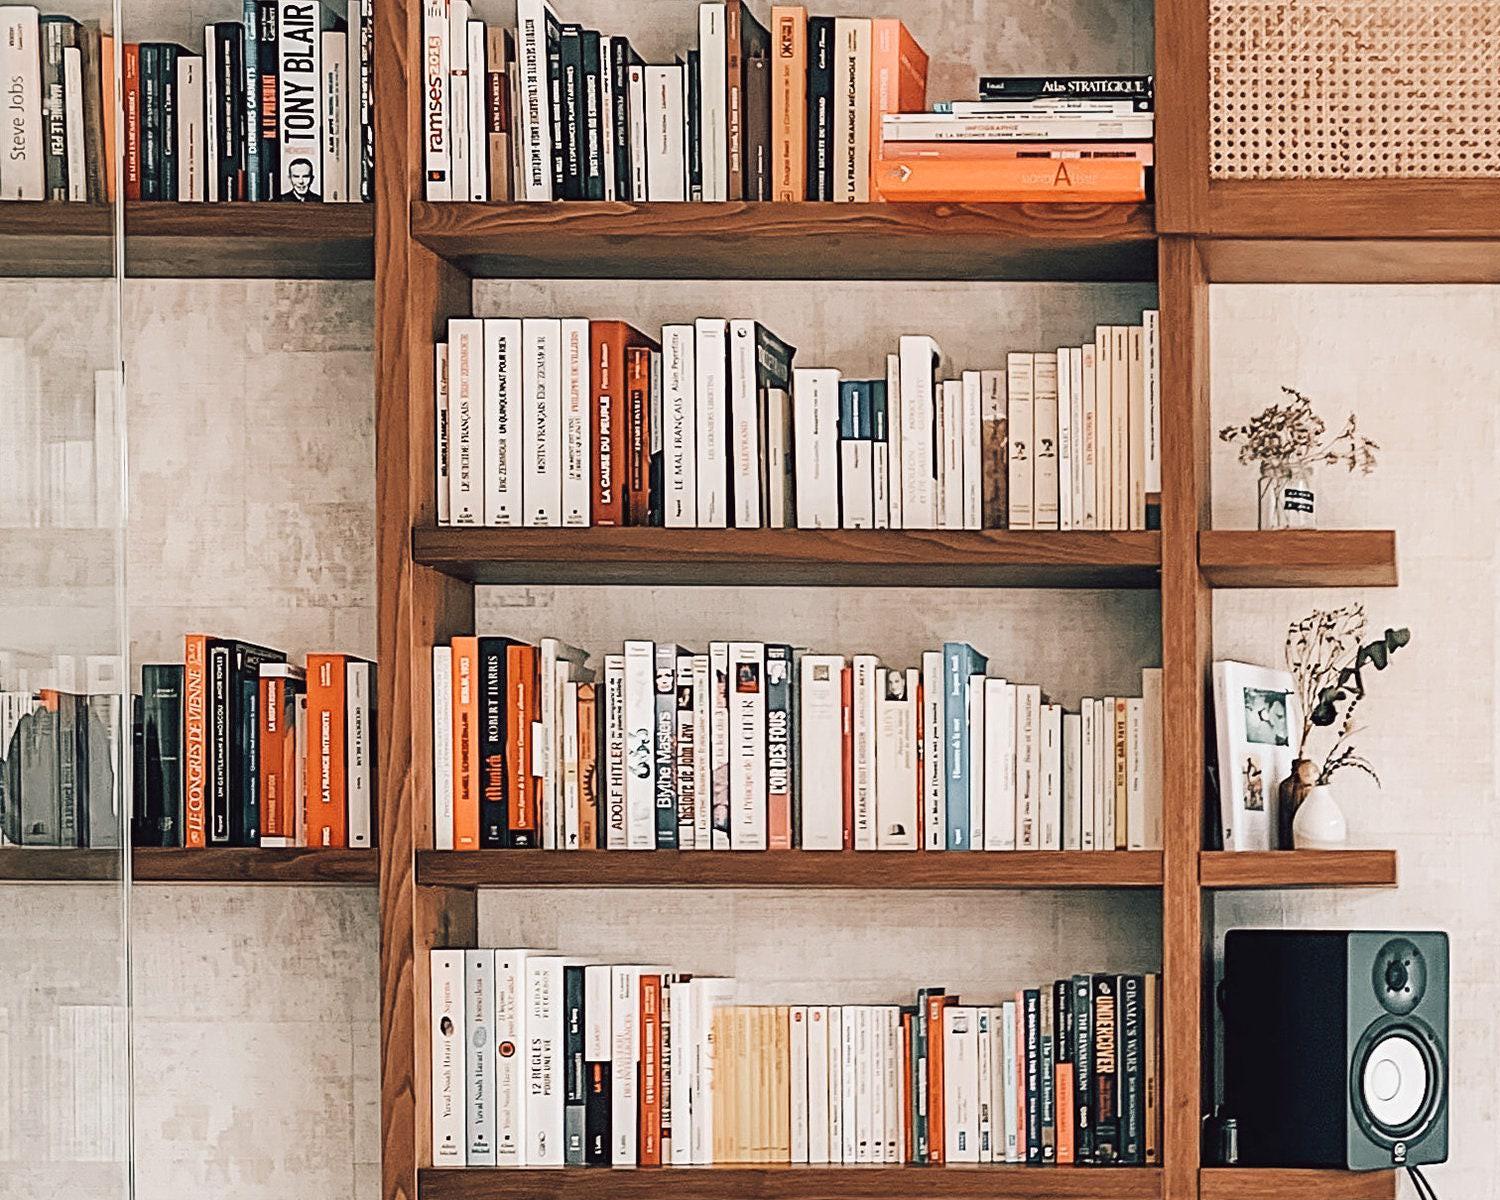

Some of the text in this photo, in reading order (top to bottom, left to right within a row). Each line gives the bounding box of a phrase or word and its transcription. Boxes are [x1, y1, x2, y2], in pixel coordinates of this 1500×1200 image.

[525, 19, 535, 46] HISTOIRE
[283, 4, 315, 144] TONY BLAIR
[846, 56, 856, 108] MÉCANIQUE
[8, 75, 26, 160] Steve Jobs
[52, 122, 62, 134] LE
[52, 135, 64, 156] PEN
[848, 146, 856, 180] FRANCE
[848, 180, 855, 192] LA
[498, 336, 506, 353] RIEN
[498, 354, 506, 373] POUR
[461, 402, 471, 492] LE SUICIDE FRANÇAIS
[498, 424, 506, 434] UN
[498, 438, 506, 476] ZEMMOUR
[537, 402, 547, 474] DESTIN FRANÇAIS
[600, 396, 610, 504] LA CAUSE DU PEUPLE
[674, 397, 684, 490] LE MAL FRANÇAIS
[268, 721, 276, 732] LA
[488, 655, 499, 742] ROBERT HARRIS
[189, 669, 202, 830] LE CONGRÈS DE VIENNE
[486, 754, 502, 801] Munich
[658, 710, 672, 808] Blythe Masters
[677, 723, 694, 826] L'histoire de John Law
[770, 710, 786, 794] L'OR DES FOUS
[218, 786, 224, 797] UN
[322, 790, 330, 802] LA
[612, 742, 623, 830] ADOLF HITLER
[444, 981, 452, 1014] Sapiens
[1126, 979, 1136, 1073] OBAMA'S WARS
[1096, 995, 1114, 1074] UNDERCOVER
[444, 1040, 452, 1118] Yuval Noah Harari
[474, 1051, 483, 1125] Yuval Noah Harari
[532, 1083, 541, 1095] 12
